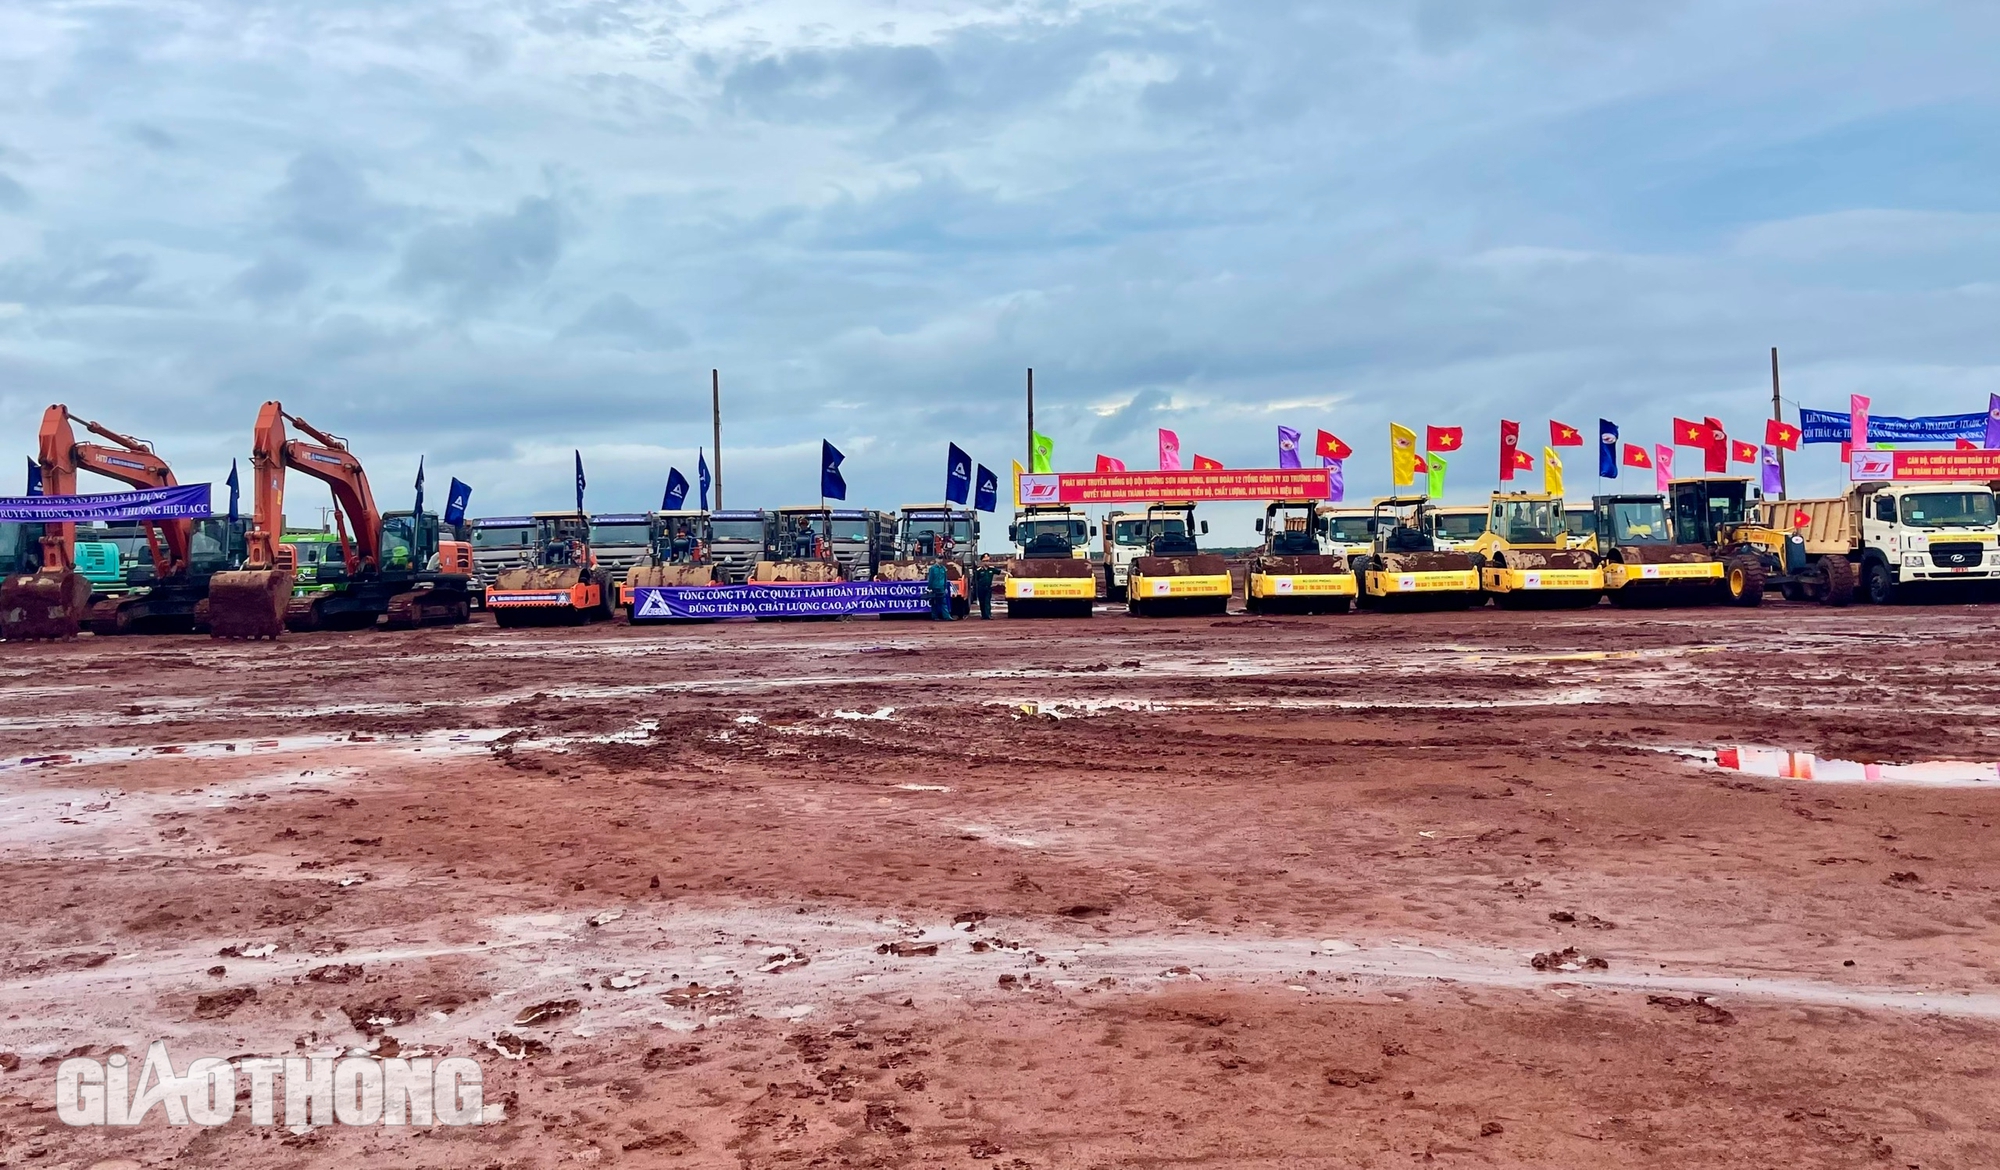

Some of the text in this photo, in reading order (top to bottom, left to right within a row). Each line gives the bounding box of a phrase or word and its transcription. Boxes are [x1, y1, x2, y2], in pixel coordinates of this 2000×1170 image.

[1804, 426, 1814, 438] GÓI
[1814, 426, 1832, 438] THẦU
[1984, 456, 1990, 464] 12
[107, 506, 119, 516] VÀ
[163, 503, 187, 516] HIỆU
[187, 503, 208, 513] ACC
[678, 589, 705, 600] TỔNG
[706, 588, 734, 600] CÔNG
[734, 590, 748, 600] TY
[749, 589, 769, 599] ACC
[769, 585, 802, 601] QUYẾT
[803, 585, 824, 598] TÂM
[826, 585, 853, 597] HOÀN
[854, 584, 888, 596] THÀNH
[889, 584, 917, 596] CÔNG
[688, 602, 716, 613] ĐÚNG
[717, 602, 740, 613] TIẾN
[740, 602, 758, 614] ĐỘ,
[758, 601, 785, 612] CHẤT
[786, 600, 820, 613] LƯỢNG
[821, 601, 844, 611] CAO,
[844, 600, 860, 610] AN
[860, 598, 886, 609] TOÀN
[888, 598, 919, 610] TUYỆT
